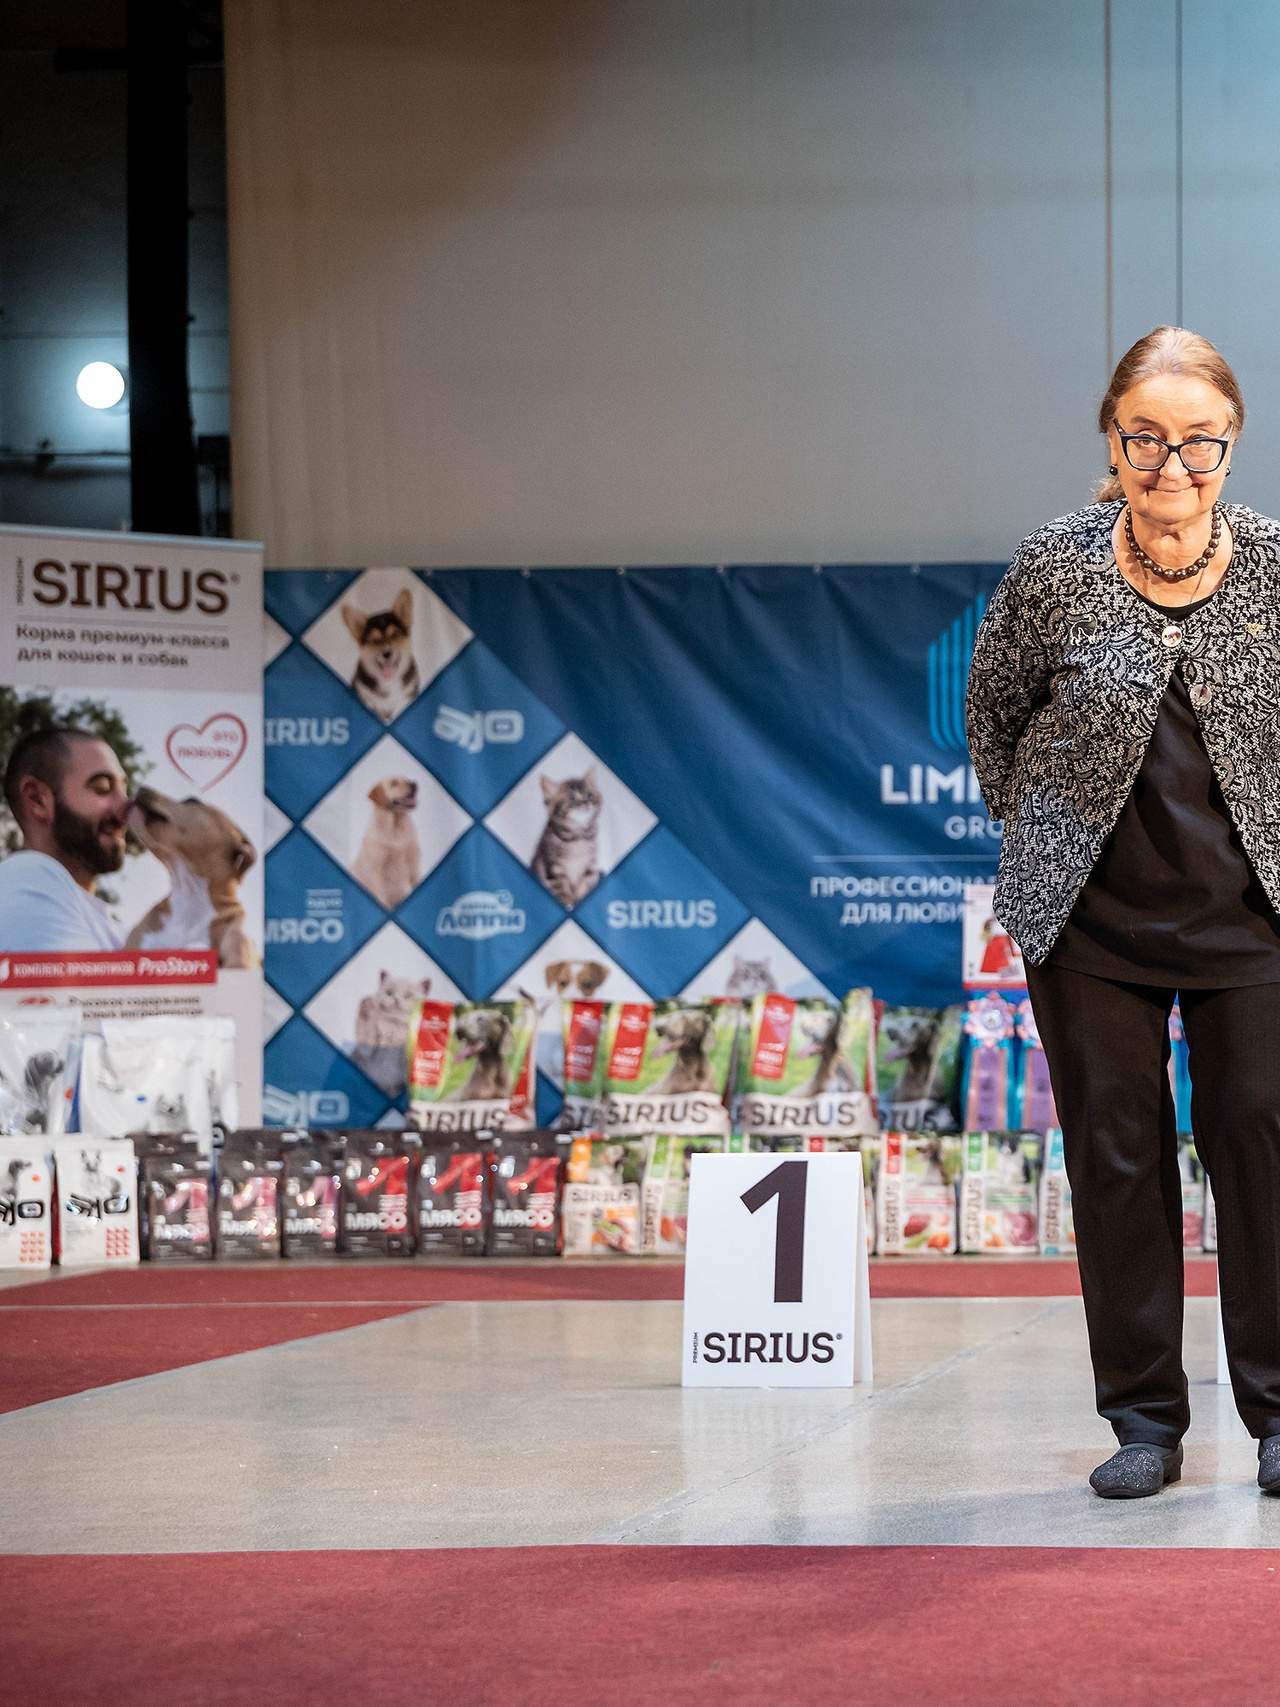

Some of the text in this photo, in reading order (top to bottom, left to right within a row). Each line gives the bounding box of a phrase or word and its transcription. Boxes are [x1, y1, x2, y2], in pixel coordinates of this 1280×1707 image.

[32, 558, 230, 615] SIRIUS
[265, 717, 350, 745] IRIUS
[607, 900, 718, 929] SIRIUS
[841, 902, 892, 926] ДЛЯ
[606, 1102, 709, 1125] SIRIUS
[751, 1102, 856, 1126] SIRIUS
[740, 1161, 808, 1302] 1
[703, 1332, 834, 1363] SIRIUS
